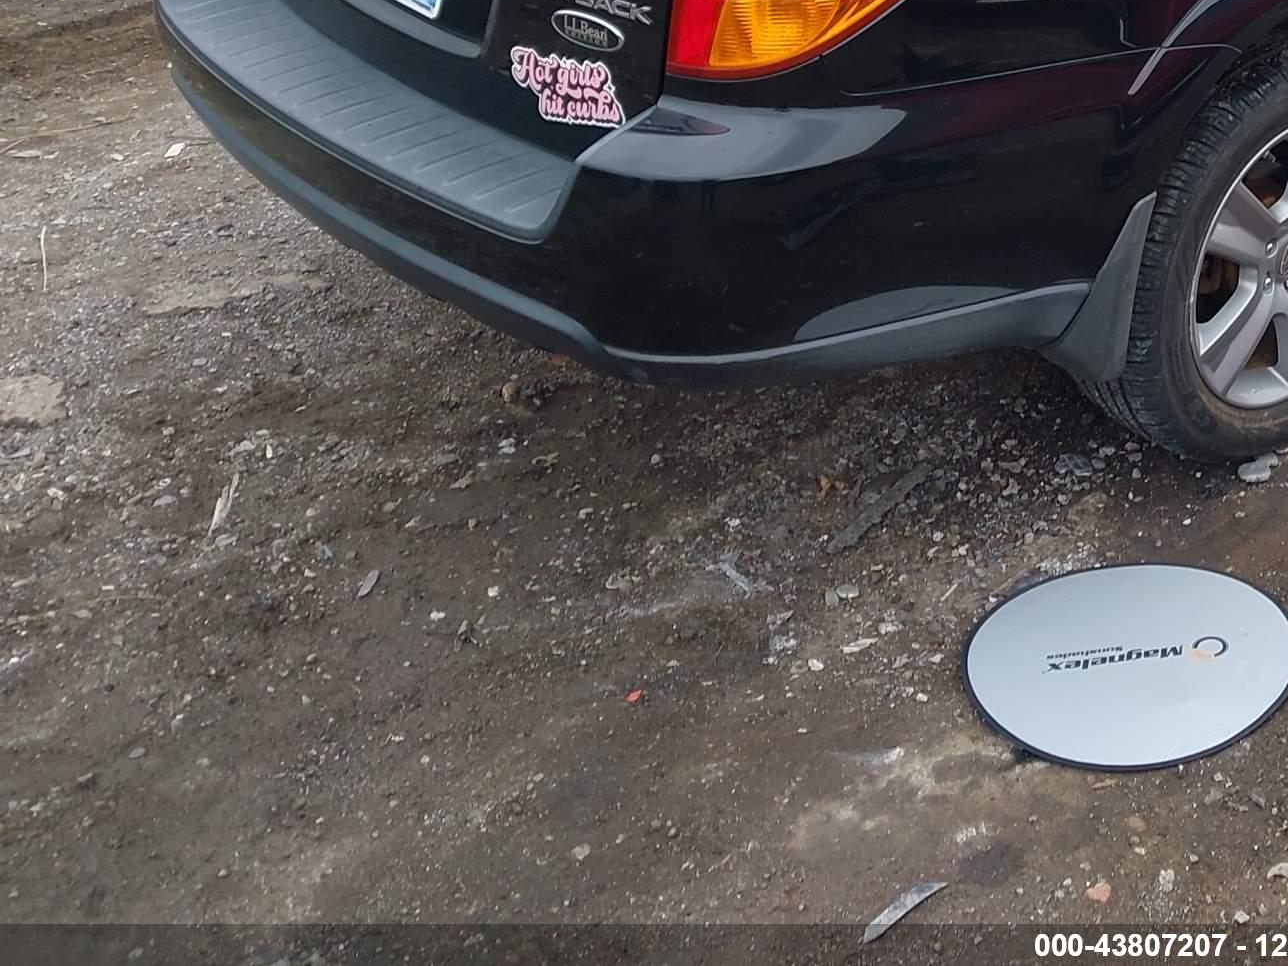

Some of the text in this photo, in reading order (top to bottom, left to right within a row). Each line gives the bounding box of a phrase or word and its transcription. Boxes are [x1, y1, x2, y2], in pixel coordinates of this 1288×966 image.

[512, 50, 608, 98] Hot girls
[542, 86, 621, 122] hit curbs
[1047, 644, 1183, 672] Magnelex
